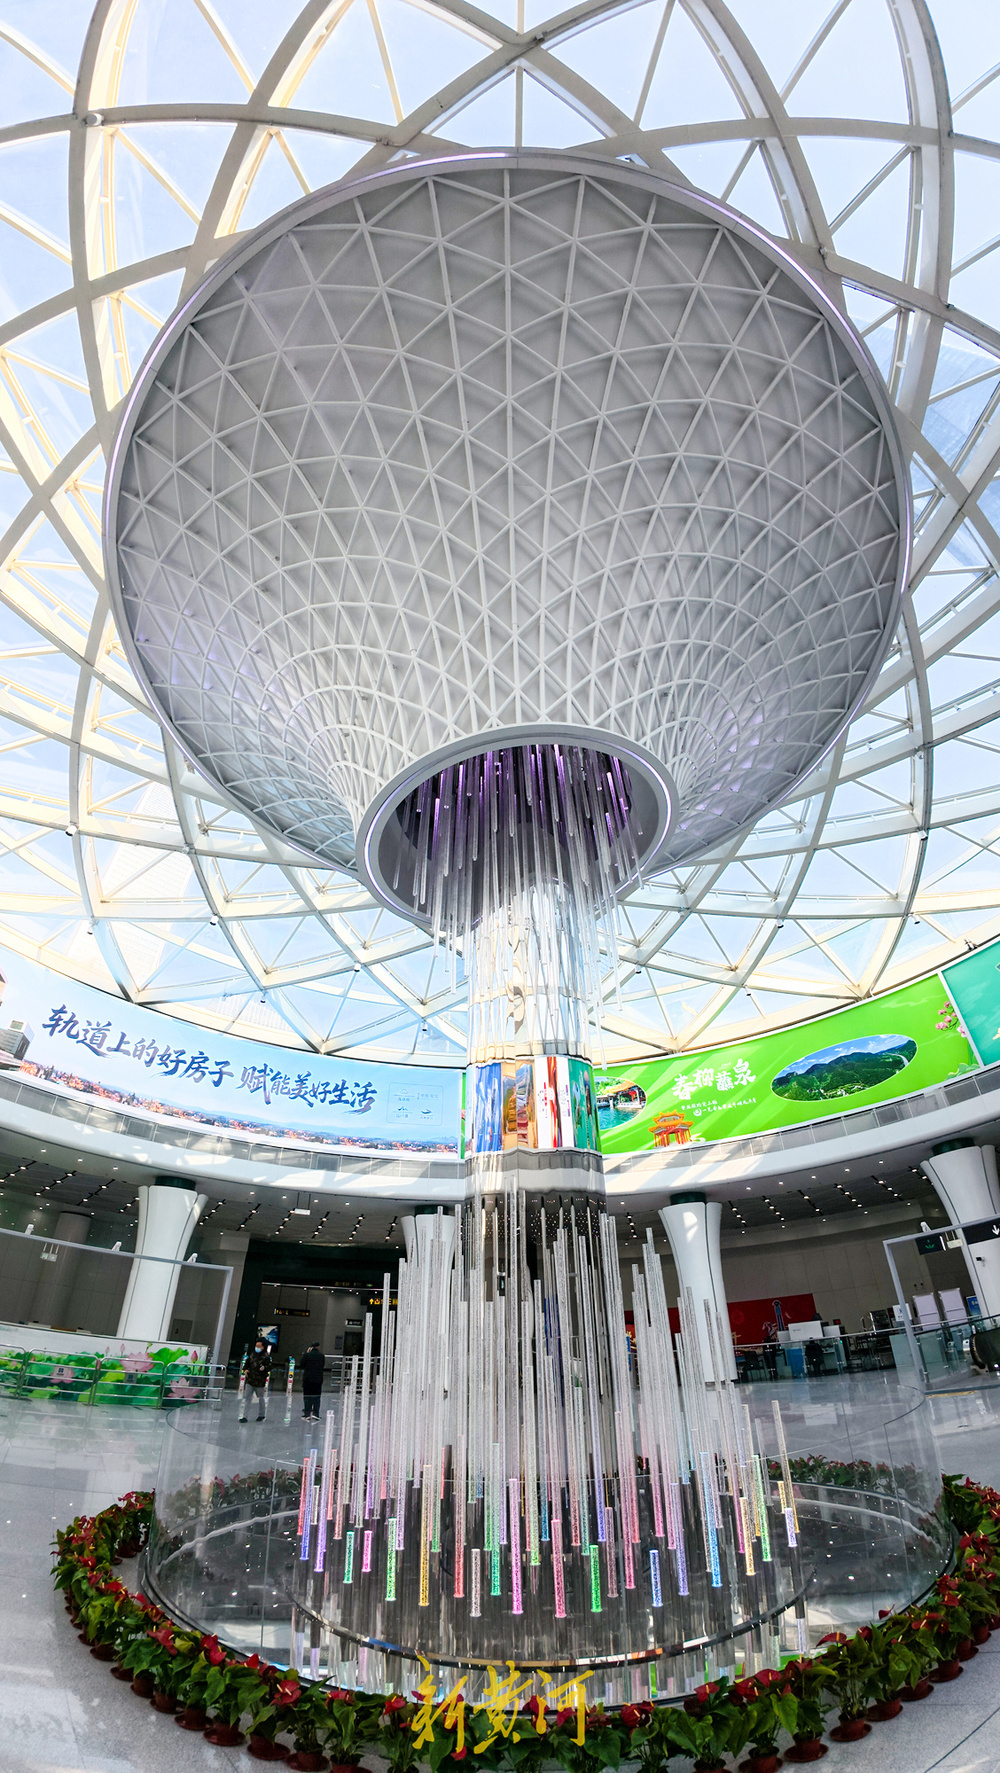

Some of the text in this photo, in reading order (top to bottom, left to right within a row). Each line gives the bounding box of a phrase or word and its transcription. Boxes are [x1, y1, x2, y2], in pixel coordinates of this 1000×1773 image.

[41, 1003, 378, 1115] 轨道上的好房子 赋能美好生活
